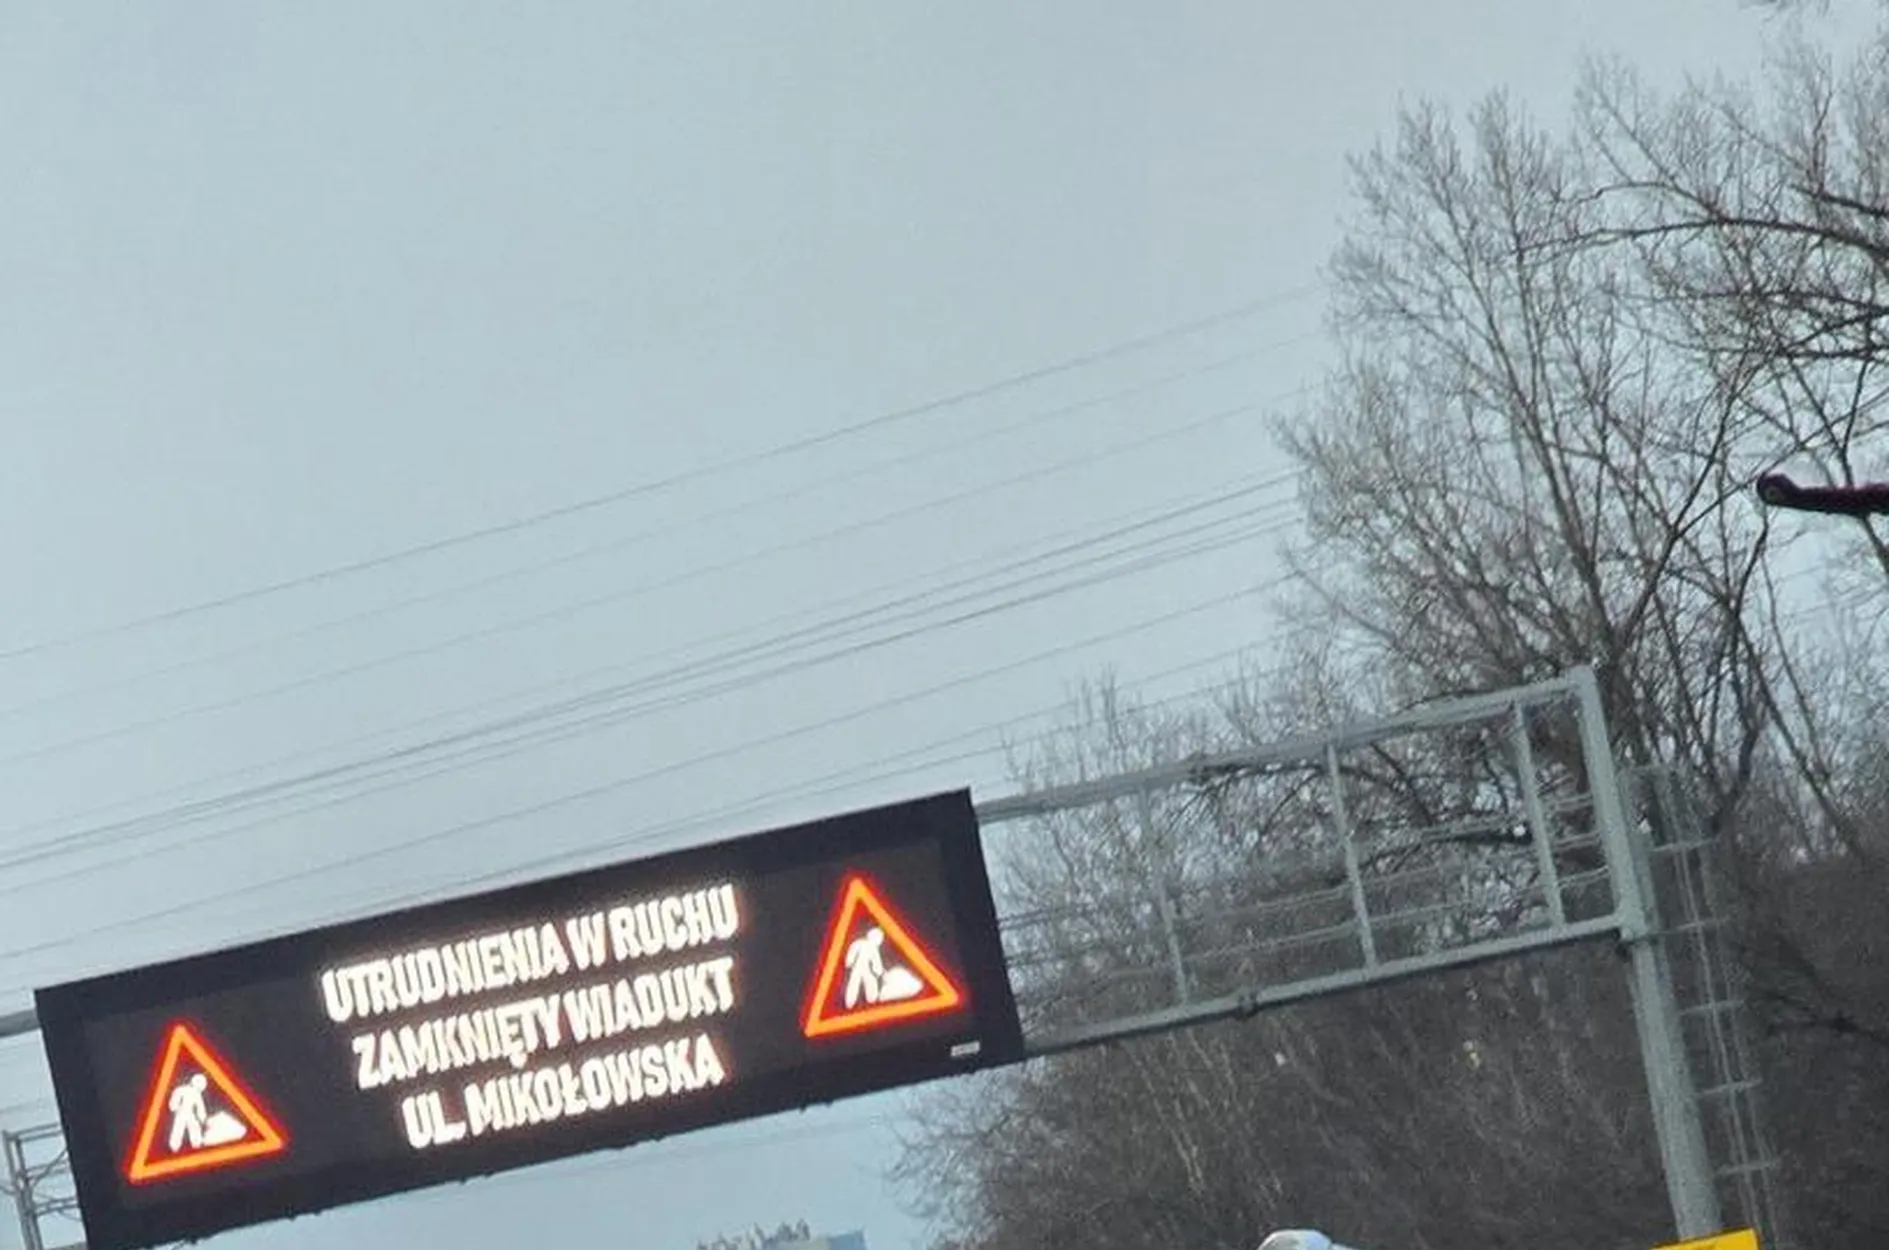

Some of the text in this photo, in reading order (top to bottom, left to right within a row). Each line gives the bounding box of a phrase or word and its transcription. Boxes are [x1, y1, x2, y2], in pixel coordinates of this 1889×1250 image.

[322, 884, 740, 1023] UTRUDNIENIA W RUCHU
[351, 957, 736, 1090] ZAMKNIĘTY WIADUKT
[401, 1034, 727, 1149] UL. MIKOŁOWSKA
